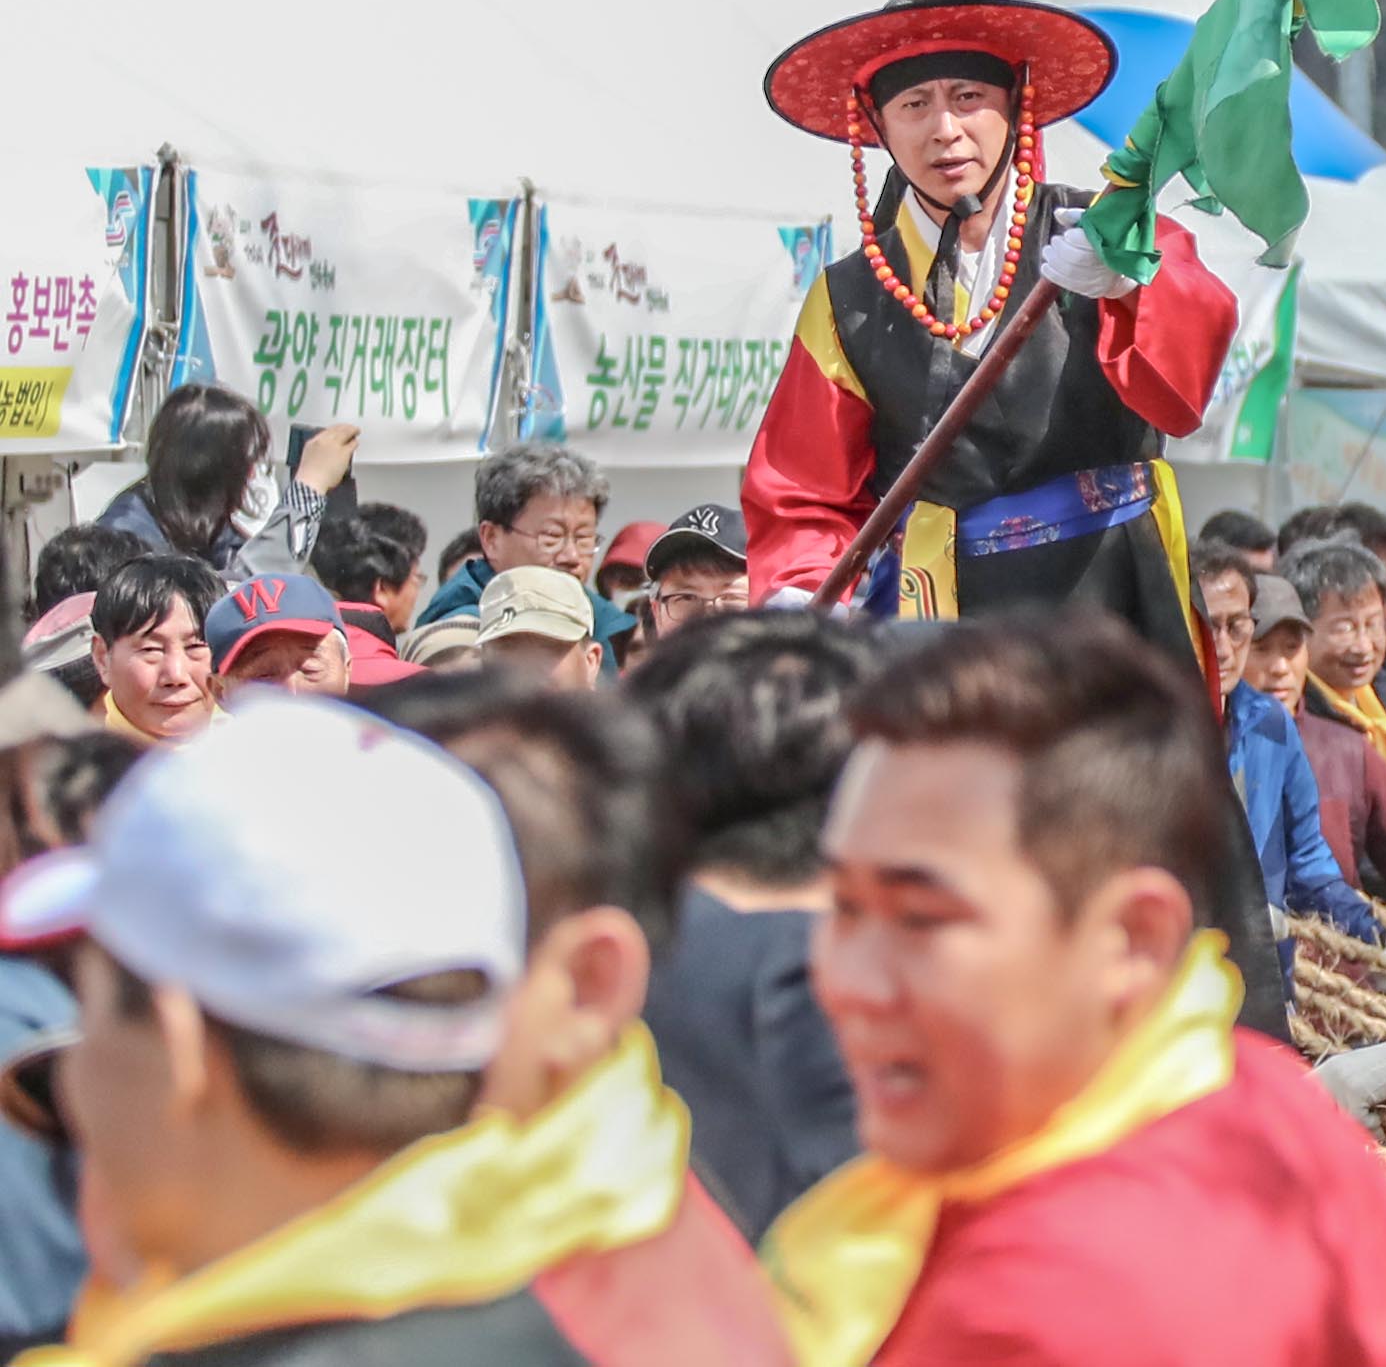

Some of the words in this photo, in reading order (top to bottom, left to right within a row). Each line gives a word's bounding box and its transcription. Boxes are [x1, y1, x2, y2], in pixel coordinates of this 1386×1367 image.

[6, 270, 97, 355] 홍보판촉
[0, 380, 54, 432] 농법인)
[253, 309, 319, 418] 광양
[324, 314, 452, 421] 직거래장터
[586, 333, 667, 431] 농산물
[232, 578, 287, 624] W
